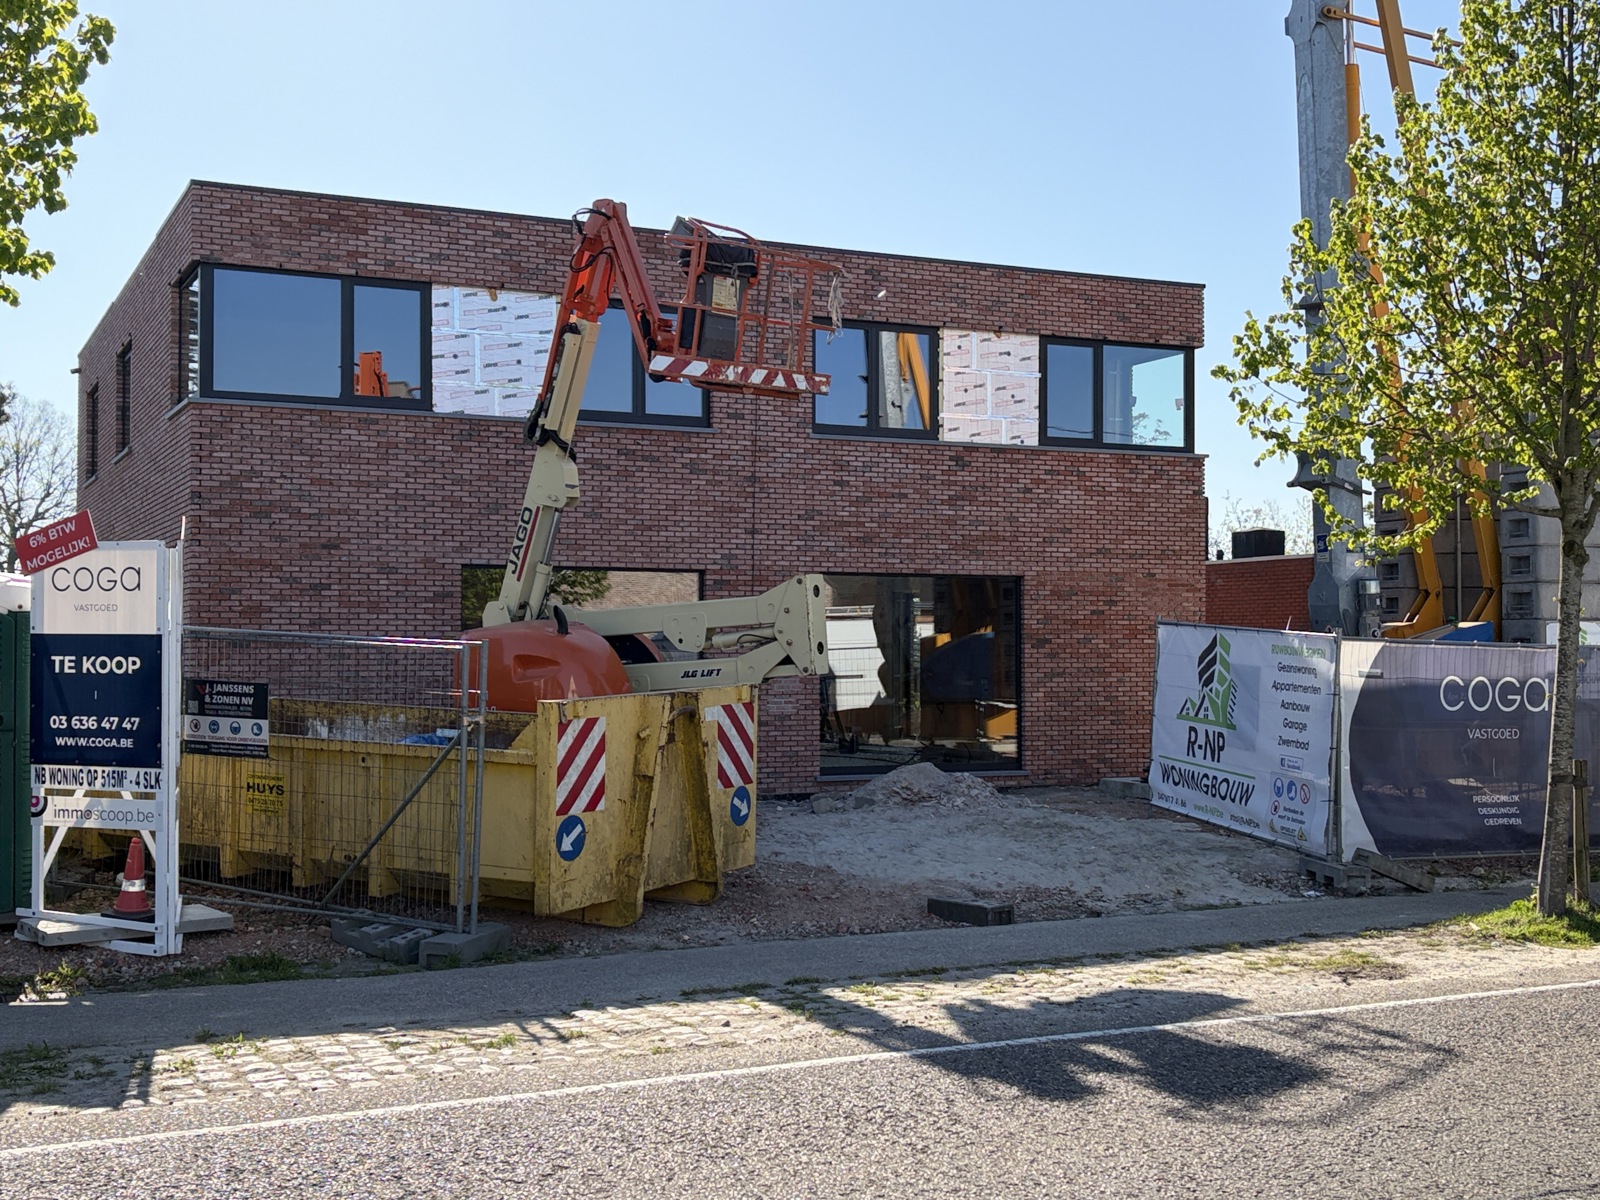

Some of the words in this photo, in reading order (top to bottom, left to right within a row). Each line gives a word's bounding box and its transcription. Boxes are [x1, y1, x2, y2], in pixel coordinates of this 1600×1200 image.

[29, 533, 47, 548] 6%
[48, 519, 77, 541] BTW
[508, 506, 533, 575] JAGO
[25, 536, 91, 571] MOGELIJK!
[74, 603, 118, 612] VASTGOED
[50, 655, 76, 674] TE
[82, 656, 141, 675] KOOP
[681, 669, 698, 679] JLG
[700, 668, 722, 678] LIFT
[213, 683, 255, 694] JANSSENS
[1271, 680, 1322, 696] Appartementen
[204, 694, 211, 703] &
[212, 695, 240, 704] ZONEN
[241, 696, 254, 705] NV
[1280, 699, 1311, 713] Aanbouw
[49, 715, 68, 729] 03
[71, 715, 98, 730] 636
[100, 716, 119, 730] 47
[121, 717, 140, 731] 47
[1282, 717, 1308, 733] Garage
[1467, 728, 1520, 740] VASTGOED
[55, 736, 134, 748] WWW.COGA.BE
[1187, 725, 1226, 763] R-NP
[34, 766, 46, 785] NB
[48, 766, 84, 787] WONING
[86, 769, 98, 788] OP
[134, 771, 141, 789] 4
[1159, 761, 1255, 807] WONINGBOUW
[246, 782, 285, 796] HUYS
[1473, 794, 1520, 804] PERSOONLIJK
[54, 804, 155, 825] immoscoop.be
[1478, 806, 1520, 815] DESKUNDIG
[1484, 817, 1523, 826] GEDREVEN
